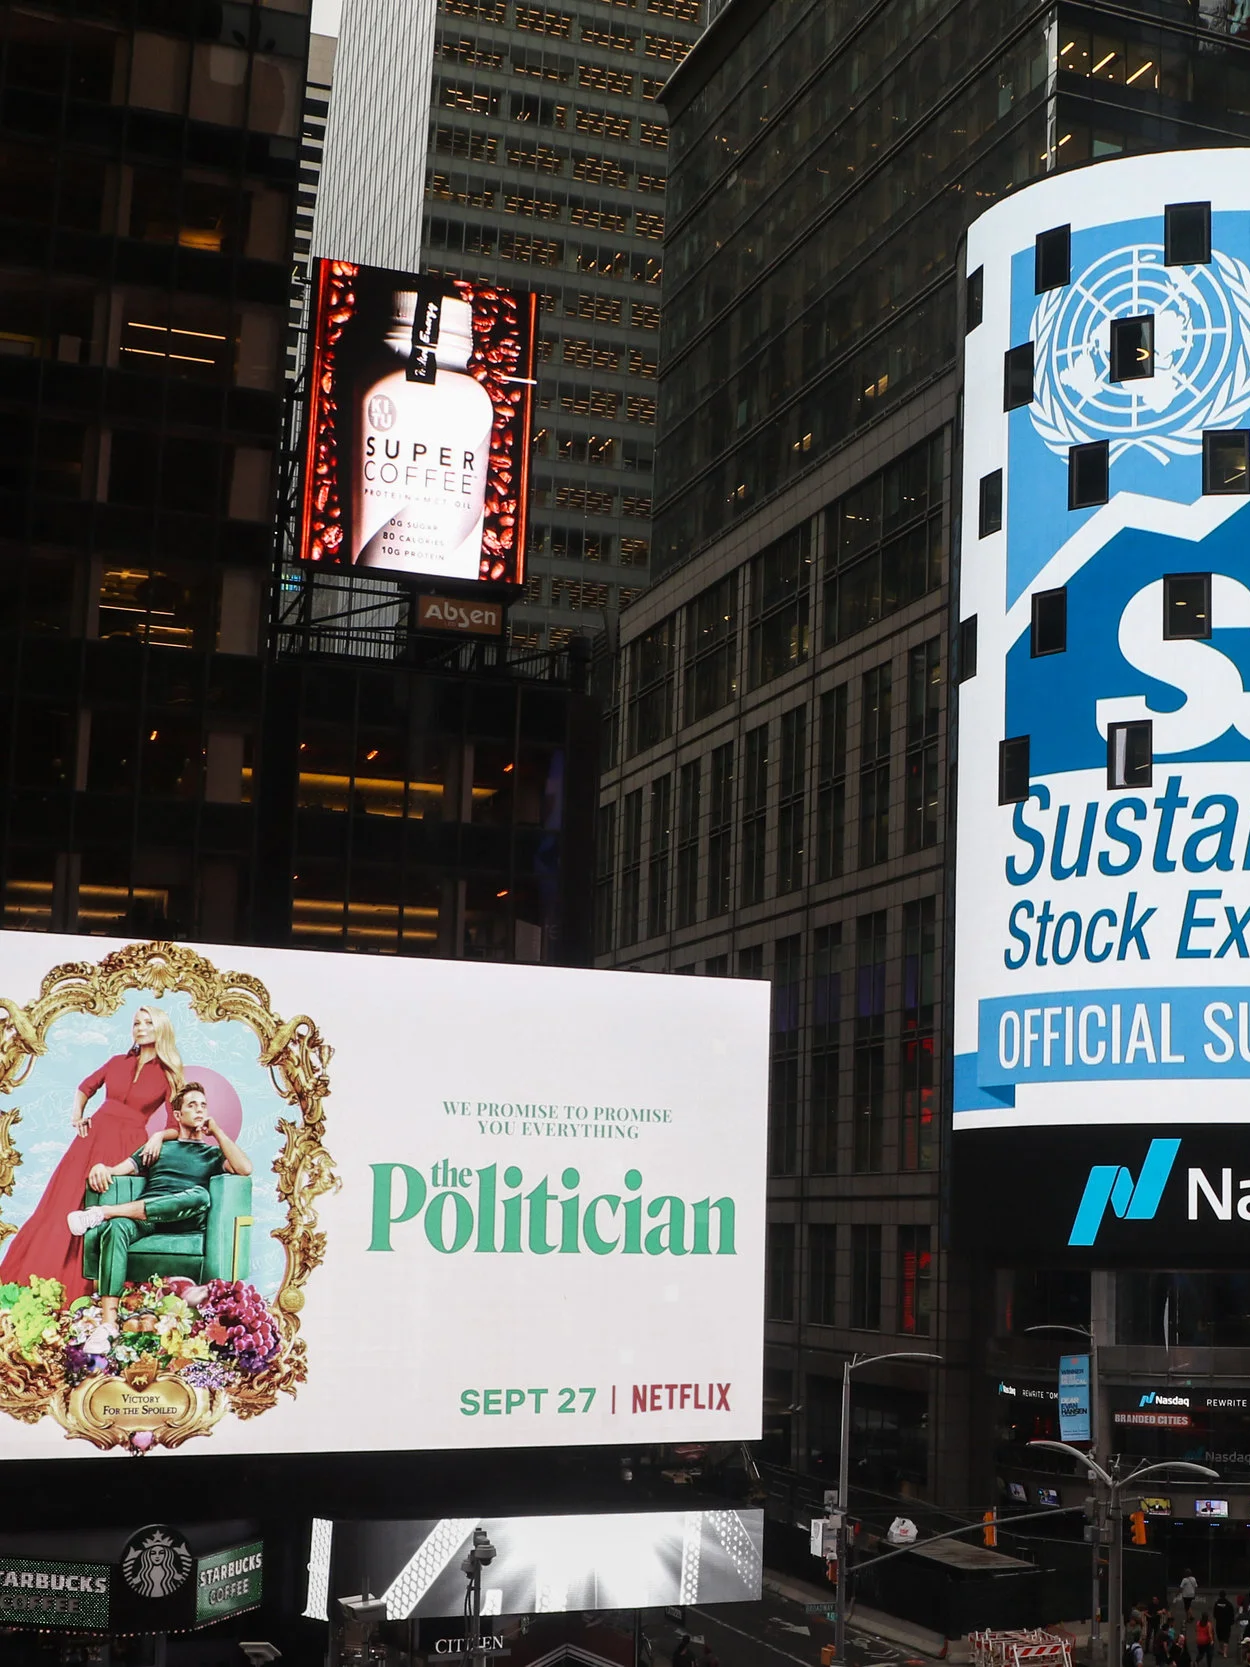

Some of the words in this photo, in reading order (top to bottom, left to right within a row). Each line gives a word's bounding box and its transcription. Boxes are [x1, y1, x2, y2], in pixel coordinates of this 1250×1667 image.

[366, 436, 475, 471] SUPER
[364, 460, 473, 495] COFFEE
[382, 532, 395, 540] 80
[424, 603, 497, 628] Absen
[1003, 891, 1158, 970] Stock
[998, 1003, 1186, 1069] OFFICIAL
[443, 1101, 471, 1116] WE
[476, 1102, 559, 1120] PROMISE
[563, 1105, 589, 1121] TO
[593, 1106, 673, 1124] PROMISE
[477, 1120, 515, 1136] YOU
[521, 1121, 640, 1140] EVERYTHING
[430, 1158, 473, 1188] the
[366, 1161, 738, 1257] Politician
[141, 1405, 178, 1415] SPOILED
[460, 1389, 549, 1416] SEPT
[558, 1388, 597, 1414] 27
[632, 1383, 732, 1414] NETFLIX
[1155, 1395, 1189, 1407] Nasdaq
[1206, 1399, 1247, 1408] REWRITE
[1157, 1414, 1189, 1425] CITIES
[200, 1552, 263, 1587] STARBUCKS
[0, 1594, 80, 1614] COFFEE
[209, 1578, 250, 1606] COFFEE
